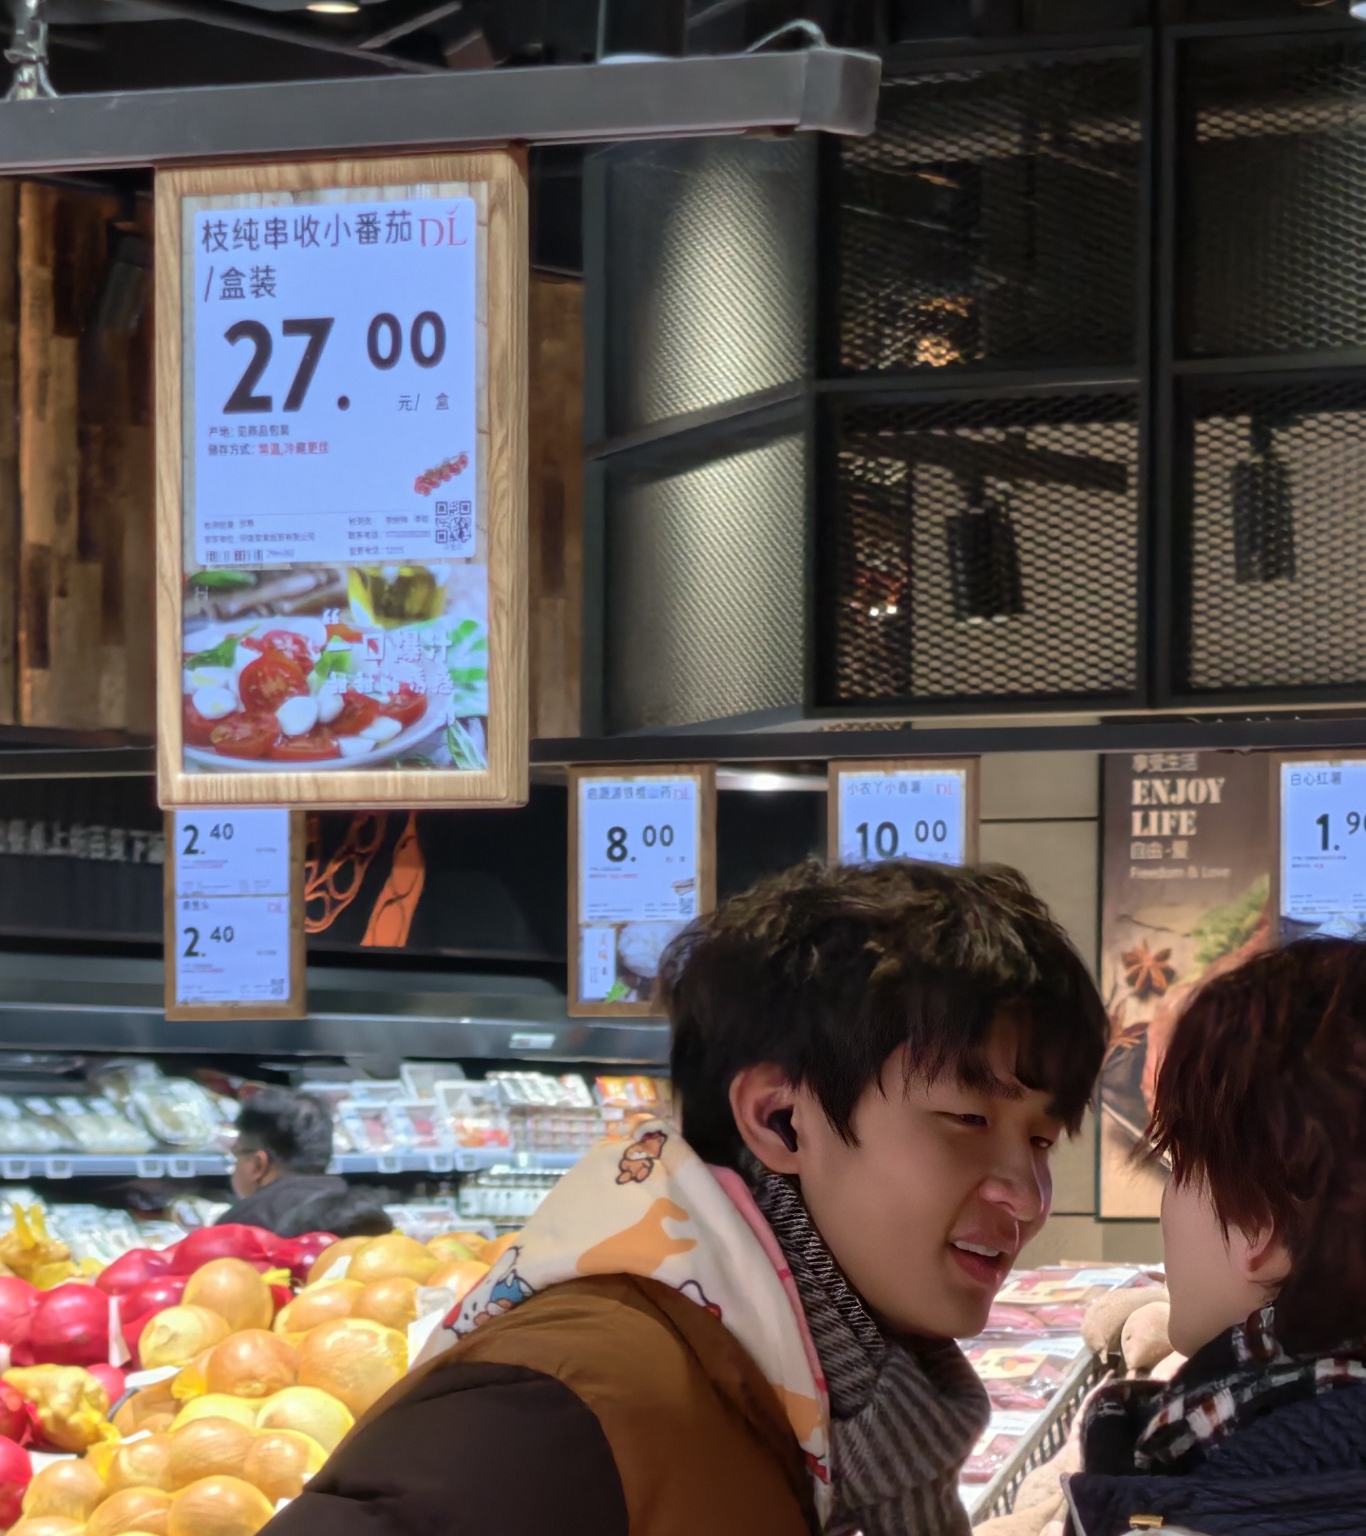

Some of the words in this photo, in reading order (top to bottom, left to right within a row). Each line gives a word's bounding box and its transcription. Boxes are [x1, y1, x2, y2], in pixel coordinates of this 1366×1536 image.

[202, 210, 413, 254] 枝纯串收小番茄
[204, 264, 278, 302] /盒装
[1132, 777, 1225, 805] ENJOY
[1132, 810, 1197, 837] LIFE
[606, 824, 674, 863] 8.00
